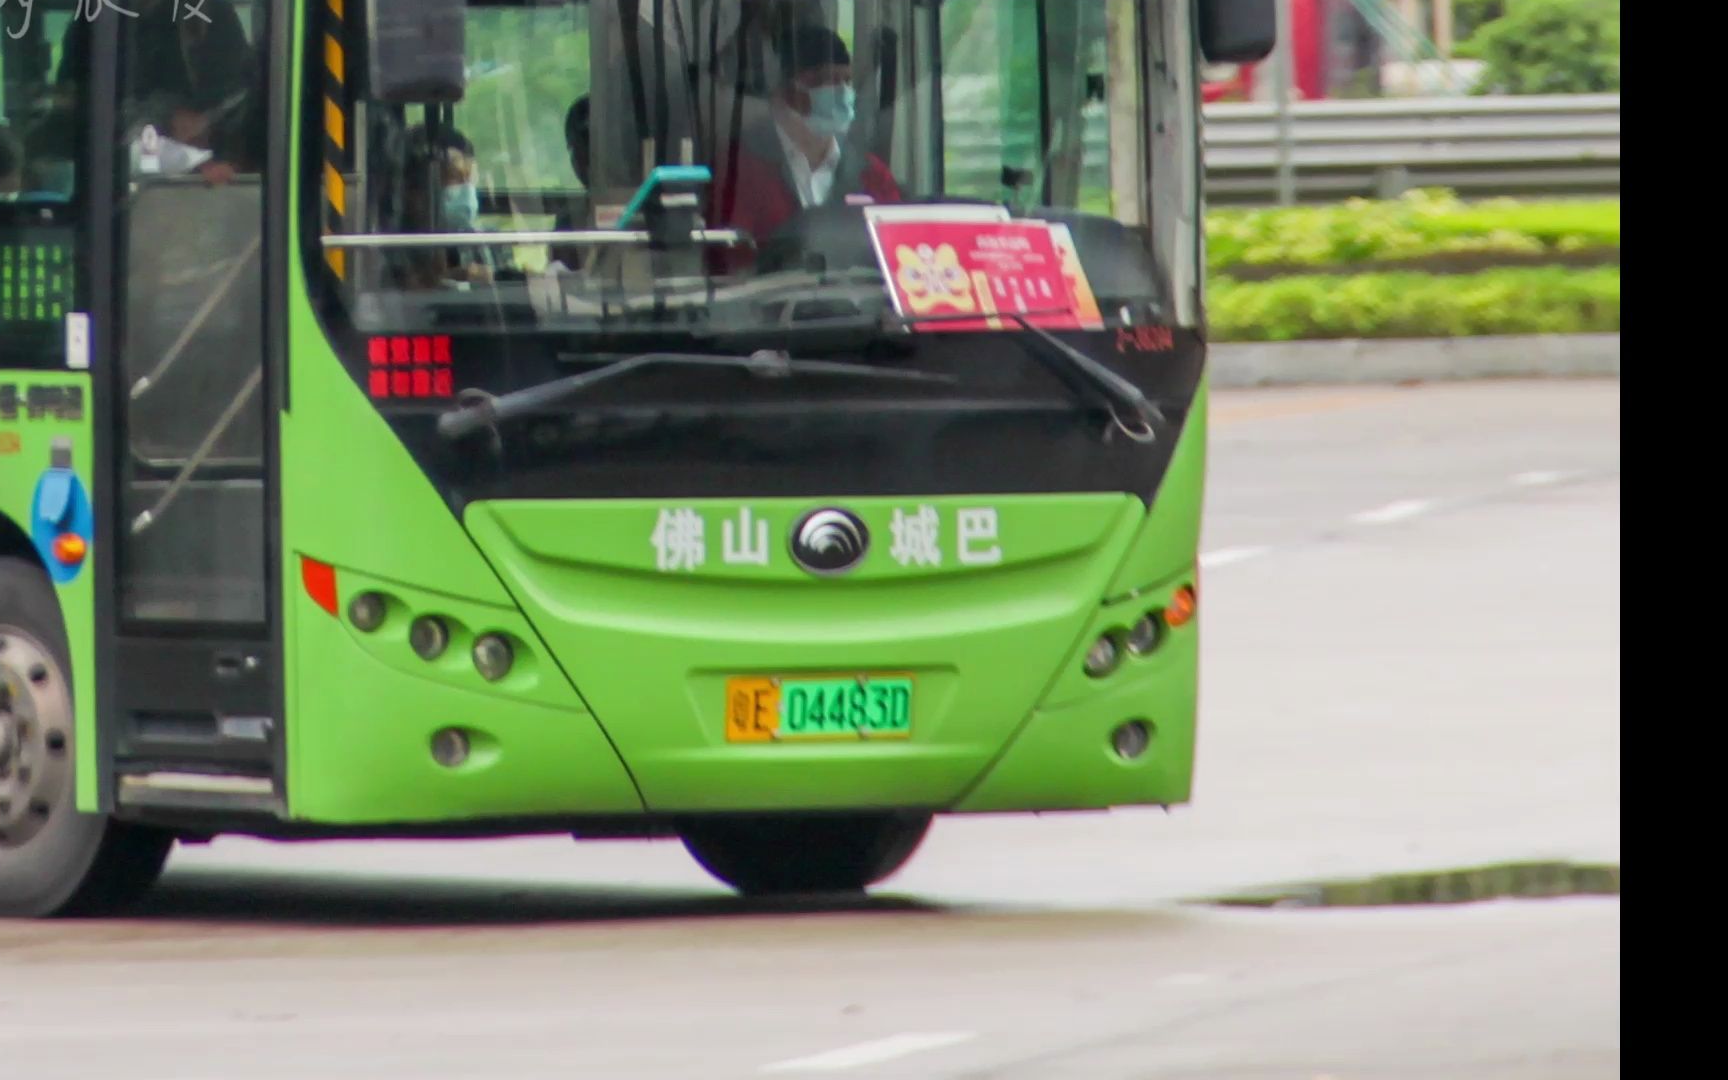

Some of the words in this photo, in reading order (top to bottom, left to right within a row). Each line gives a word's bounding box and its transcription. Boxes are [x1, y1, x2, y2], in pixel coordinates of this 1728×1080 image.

[650, 507, 768, 571] 佛山
[888, 504, 1003, 566] 城巴
[787, 685, 910, 731] 04483D
